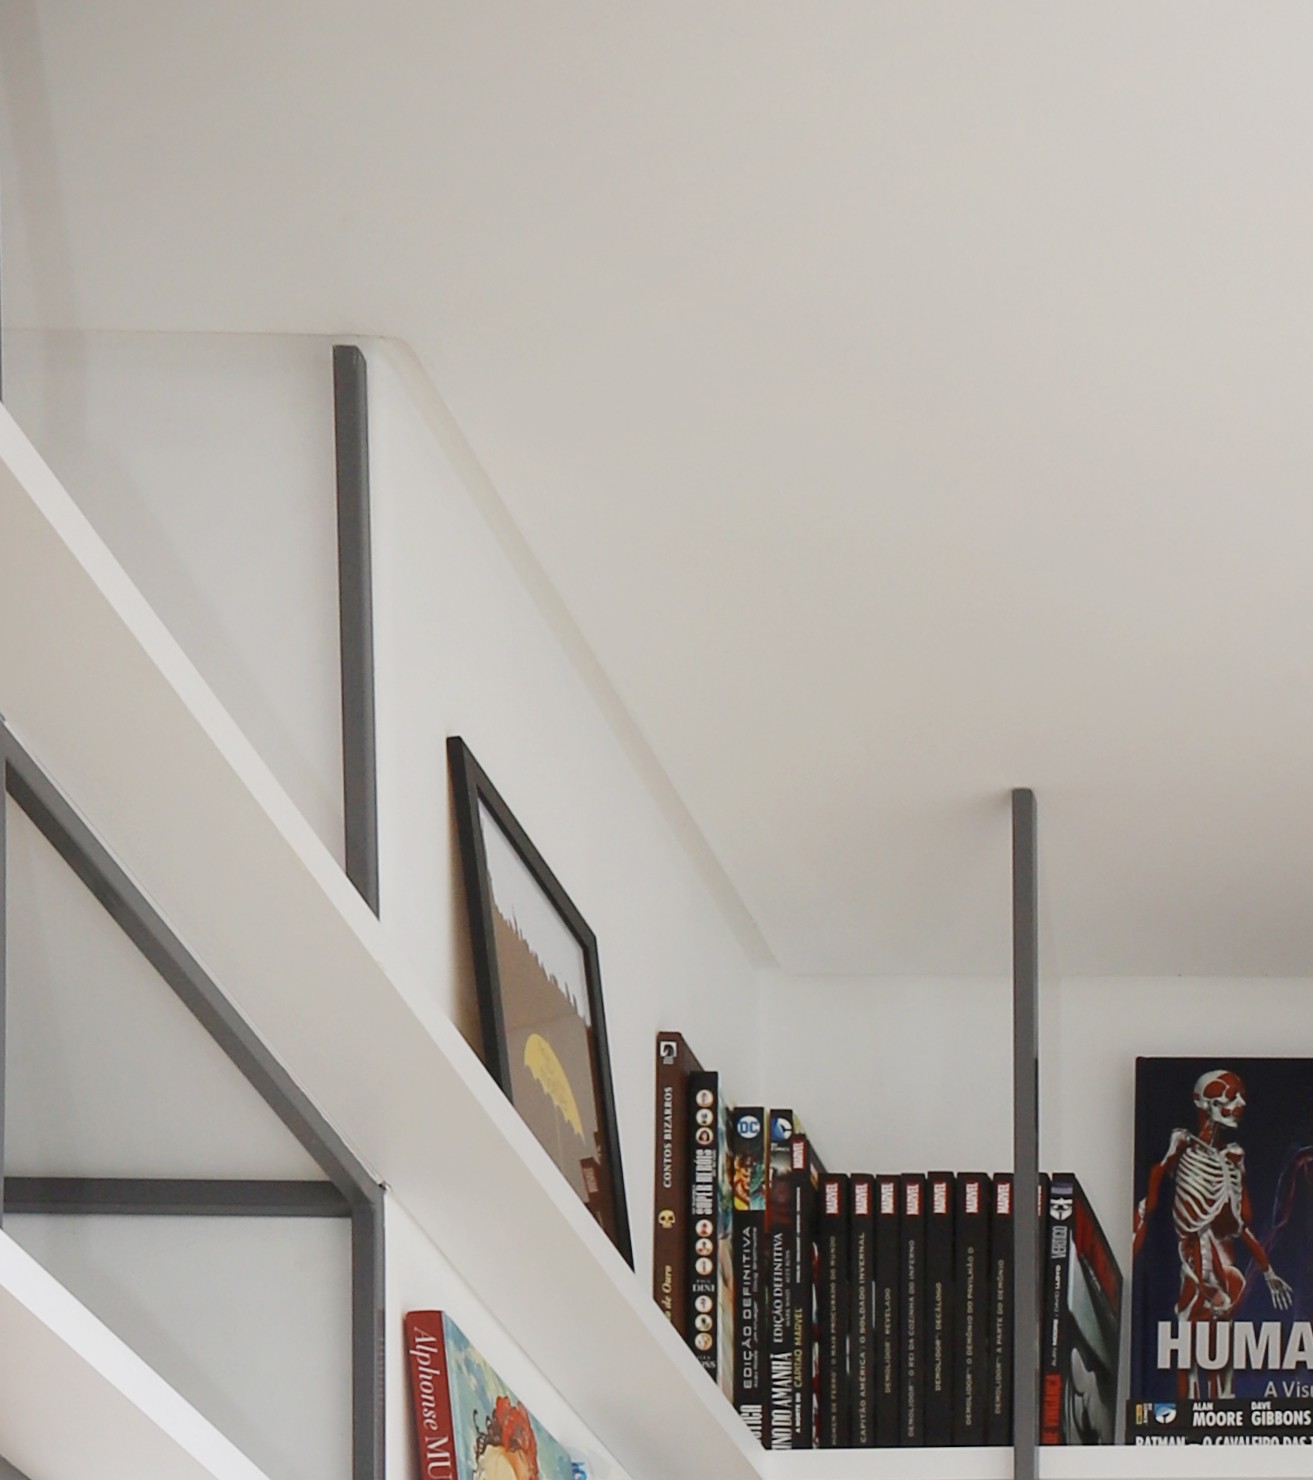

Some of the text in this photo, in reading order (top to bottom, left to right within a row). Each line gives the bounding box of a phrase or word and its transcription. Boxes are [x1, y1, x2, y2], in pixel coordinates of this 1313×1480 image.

[662, 1087, 673, 1188] CONTOS BIZARROS
[742, 1226, 755, 1389] EDIÇÃO DEFINITIVA
[413, 1326, 439, 1431] Alphonse
[1264, 1381, 1277, 1398] A
[1192, 1401, 1244, 1427] ALAN MOORE
[1251, 1401, 1312, 1427] DAVE GIBBONS
